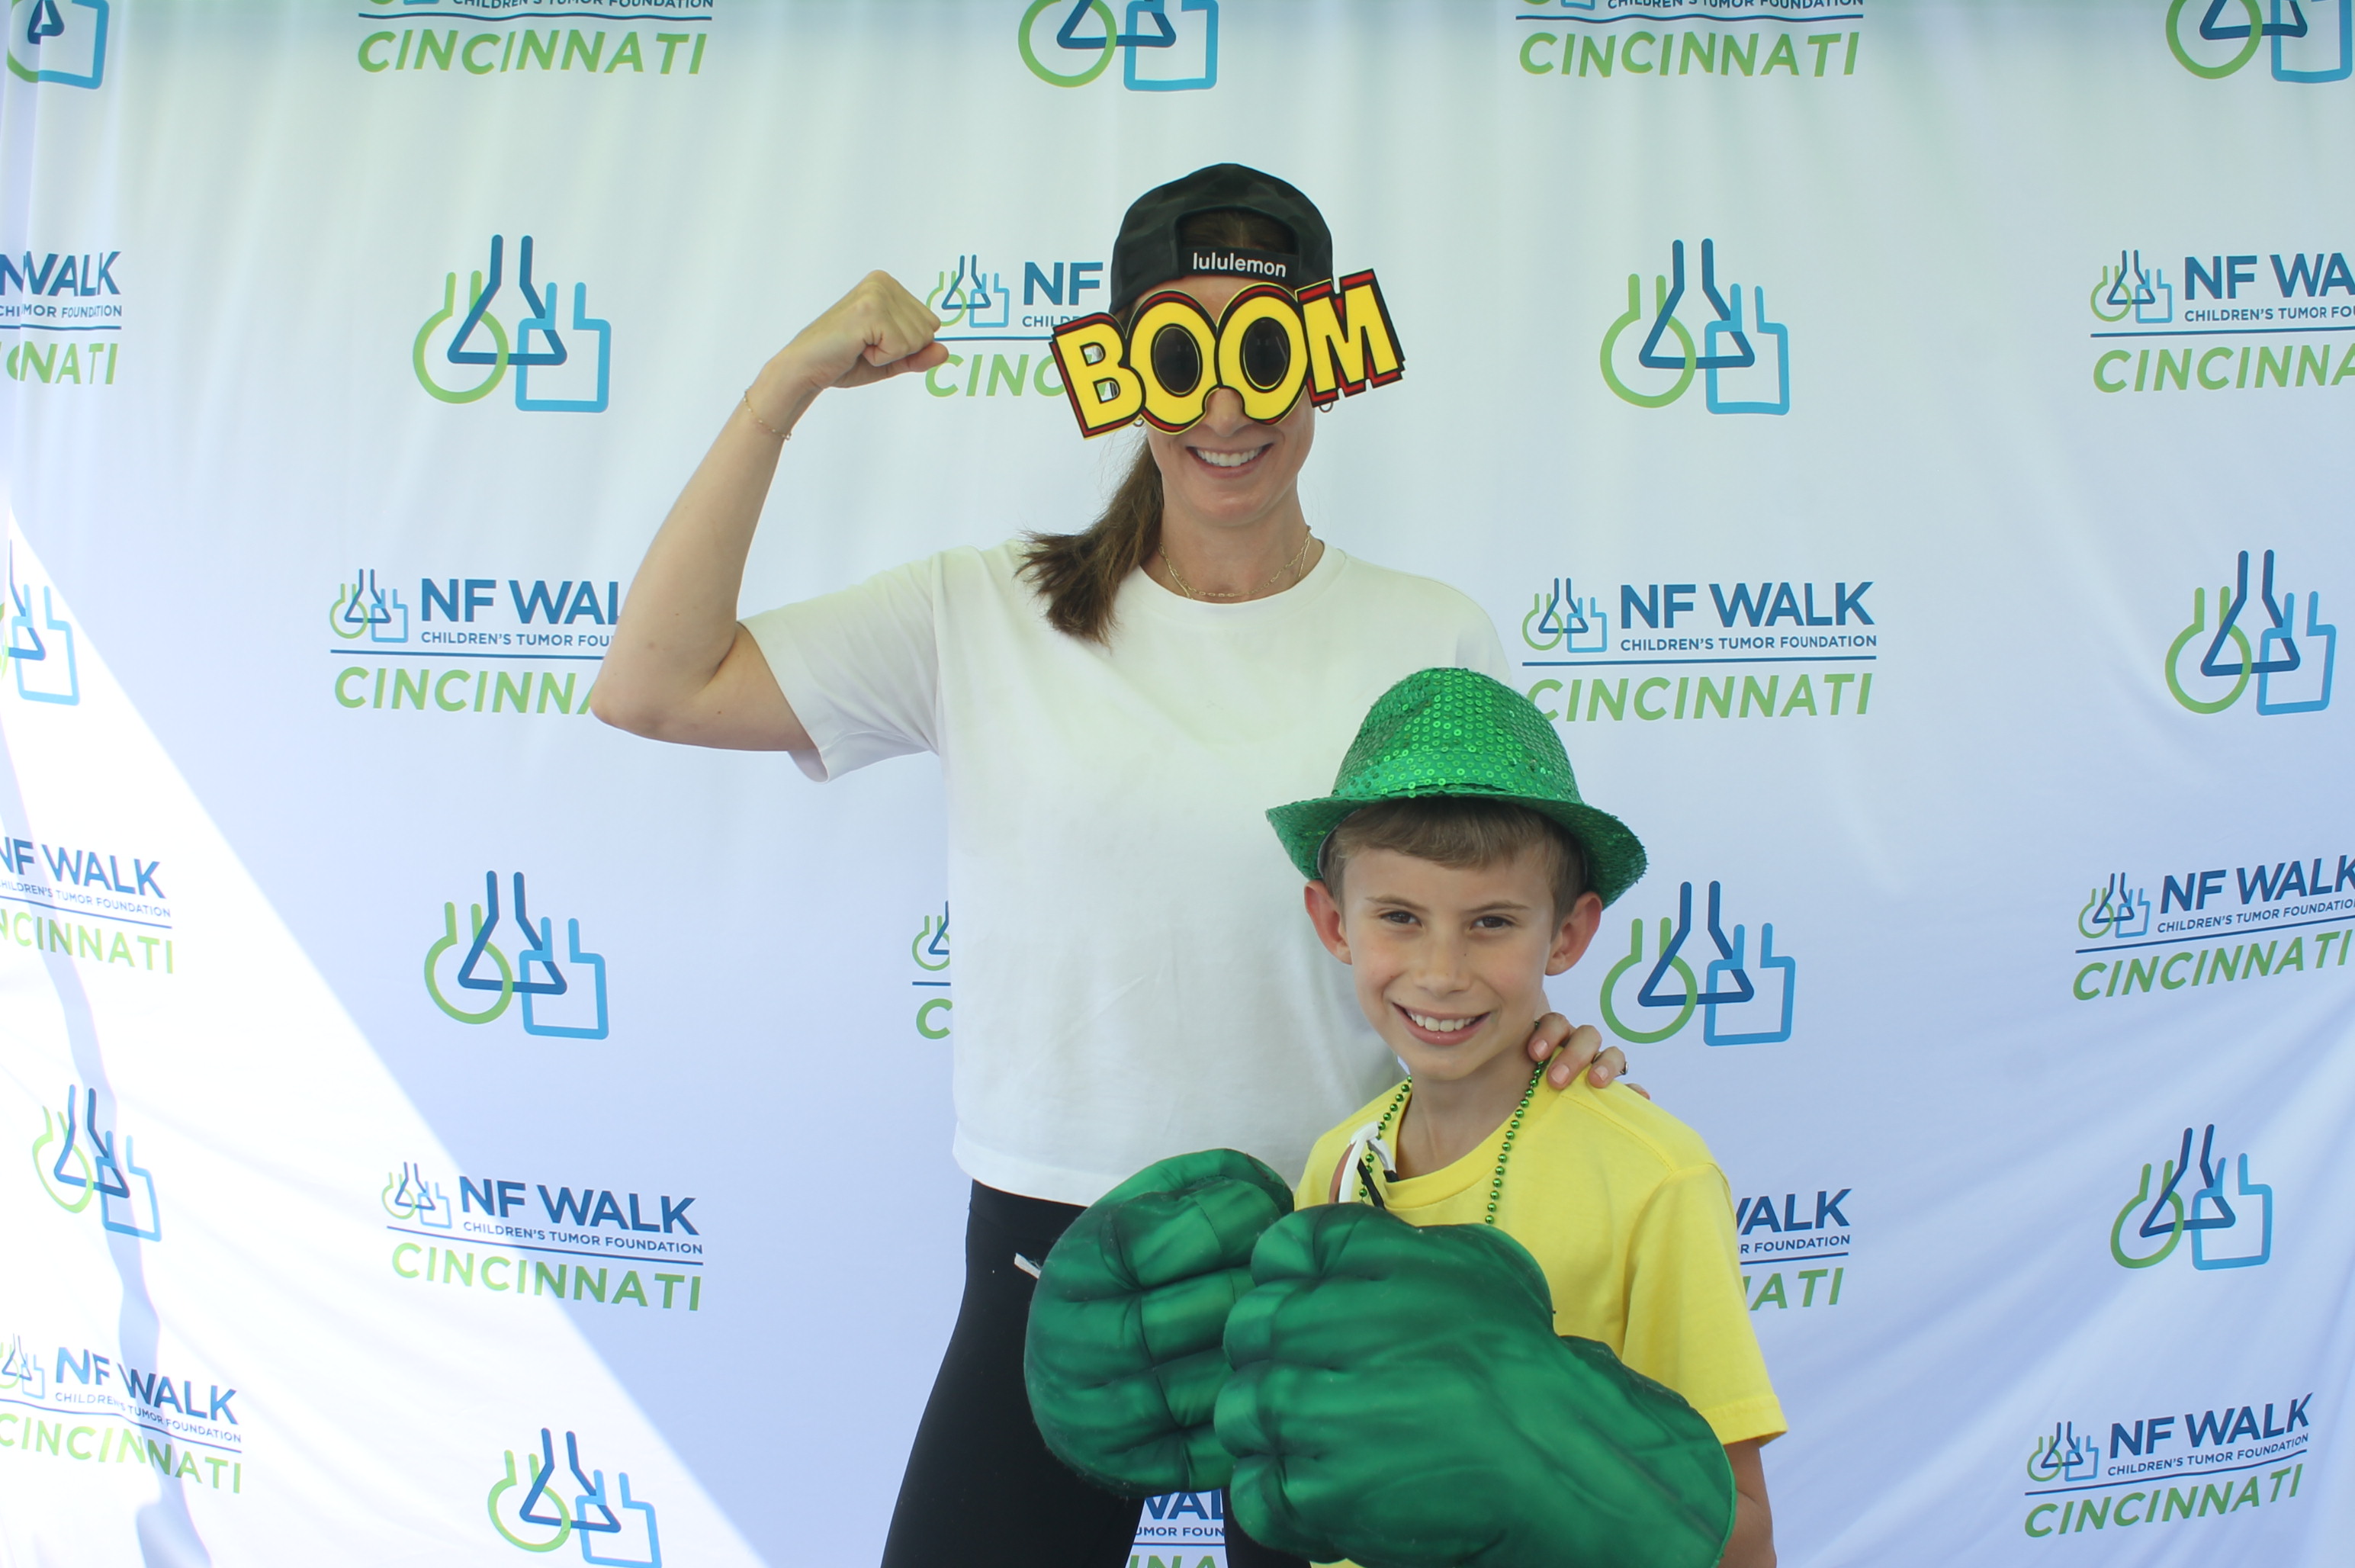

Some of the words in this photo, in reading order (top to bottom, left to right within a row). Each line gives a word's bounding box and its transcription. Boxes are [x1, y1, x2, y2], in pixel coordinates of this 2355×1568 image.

[358, 29, 707, 75] CINCINNATI
[1519, 31, 1860, 77] CINCINNATI
[1023, 262, 1104, 305] NF
[1193, 252, 1287, 278] lululemon
[2184, 255, 2257, 300] NF
[61, 305, 122, 319] FOUNDATION
[2184, 308, 2274, 322] CHILDREN'S
[2278, 307, 2327, 320] TUMOR
[1049, 268, 1406, 439] BOOM
[421, 578, 496, 622] NF
[1620, 583, 1697, 629] NF
[1708, 581, 1875, 628] WALK
[421, 631, 512, 645] CHILDREN'S
[516, 633, 573, 646] TUMOR
[1621, 638, 1714, 651] CHILDREN'S
[1718, 636, 1775, 651] TUMOR
[1780, 635, 1877, 649] FOUNDATION
[1525, 673, 1873, 722] CINCINNATI
[41, 843, 167, 899] WALK
[2160, 869, 2227, 914] NF
[2236, 855, 2355, 905] WALK
[0, 879, 53, 898] HILDREN'S
[56, 890, 93, 905] TUMOR
[97, 898, 172, 917] FOUNDATION
[2157, 914, 2233, 933] CHILDREN'S
[2236, 909, 2279, 925] TUMOR
[2283, 898, 2355, 917] FOUNDATIO
[2073, 929, 2353, 1001] CINCINNATI
[459, 1175, 526, 1218] NF
[537, 1184, 700, 1235] WALK
[464, 1221, 545, 1240] CHILDREN'S
[549, 1231, 601, 1245] TUMOR
[605, 1236, 703, 1255] FOUNDATION
[1754, 1234, 1851, 1254] FOUNDATION
[391, 1242, 702, 1312] CINCINNATI
[56, 1347, 110, 1386] NF
[117, 1362, 239, 1425] WALK
[127, 1405, 163, 1425] TUMOR
[165, 1418, 242, 1444] FOUNDATION
[2109, 1416, 2175, 1459] NF
[2184, 1392, 2313, 1448] WALK
[0, 1413, 242, 1494] CINCINNATI
[2107, 1457, 2183, 1476] CHILDREN'S
[2186, 1451, 2233, 1467] TUMOR
[2237, 1432, 2309, 1460] FOUNDATION
[2024, 1463, 2303, 1538] CINCINNATI
